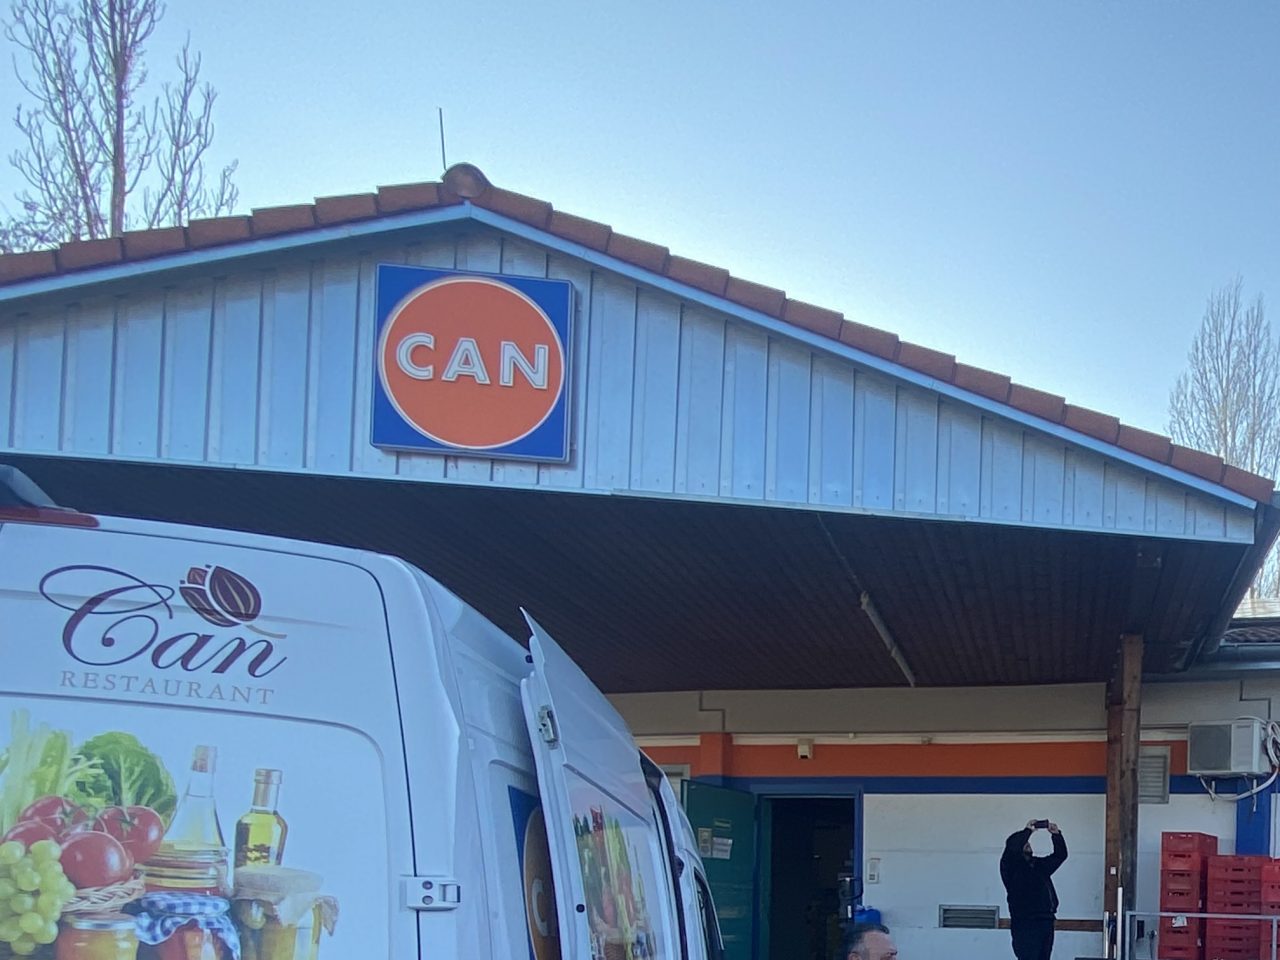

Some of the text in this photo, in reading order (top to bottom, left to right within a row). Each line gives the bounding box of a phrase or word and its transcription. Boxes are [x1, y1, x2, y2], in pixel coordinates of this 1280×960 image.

[396, 332, 549, 391] CAN
[39, 564, 288, 679] Can
[60, 670, 275, 704] RESTAURANT
